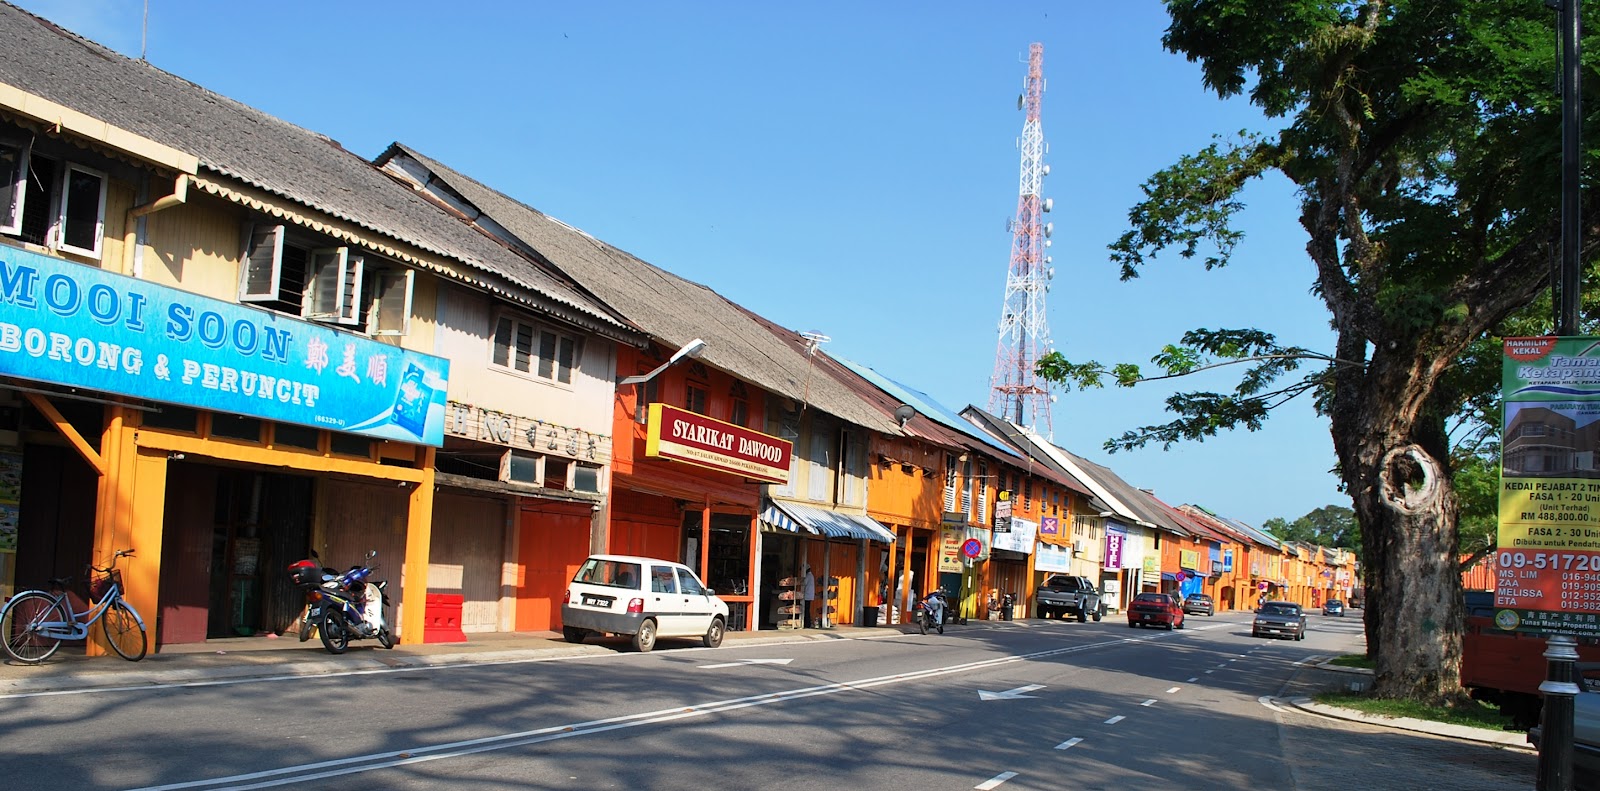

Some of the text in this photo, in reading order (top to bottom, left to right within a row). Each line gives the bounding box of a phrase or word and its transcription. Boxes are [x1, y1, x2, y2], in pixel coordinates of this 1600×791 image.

[0, 261, 293, 364] MOOI SOON
[1512, 347, 1541, 355] KEKAL
[0, 321, 320, 407] BORONG & PERUNCIT
[1550, 356, 1600, 368] Tama
[672, 419, 782, 463] SYARIKAT DAWOOD
[1505, 482, 1533, 491] KEDAI
[1535, 483, 1578, 491] PEJABAT
[1529, 493, 1553, 501] FASA
[1571, 493, 1582, 501] 20
[1539, 504, 1590, 513] (Unit Terhad)
[1521, 512, 1535, 520] RM
[1538, 512, 1589, 523] 488,800.00
[1528, 528, 1552, 536] FASA
[1556, 528, 1561, 536] 2
[1570, 529, 1581, 537] 30
[1513, 538, 1542, 547] (Dibuka
[1544, 539, 1565, 547] untuk
[1109, 535, 1119, 568] HOTEL
[1500, 552, 1600, 571] 09-51720
[1499, 570, 1516, 578] MS.
[1520, 570, 1537, 579] LIM
[1498, 579, 1519, 587] ZAA
[1498, 588, 1543, 598] MELISSA
[1497, 597, 1516, 605] ETA
[1521, 618, 1541, 626] Tunas
[1563, 621, 1597, 630] Properties
